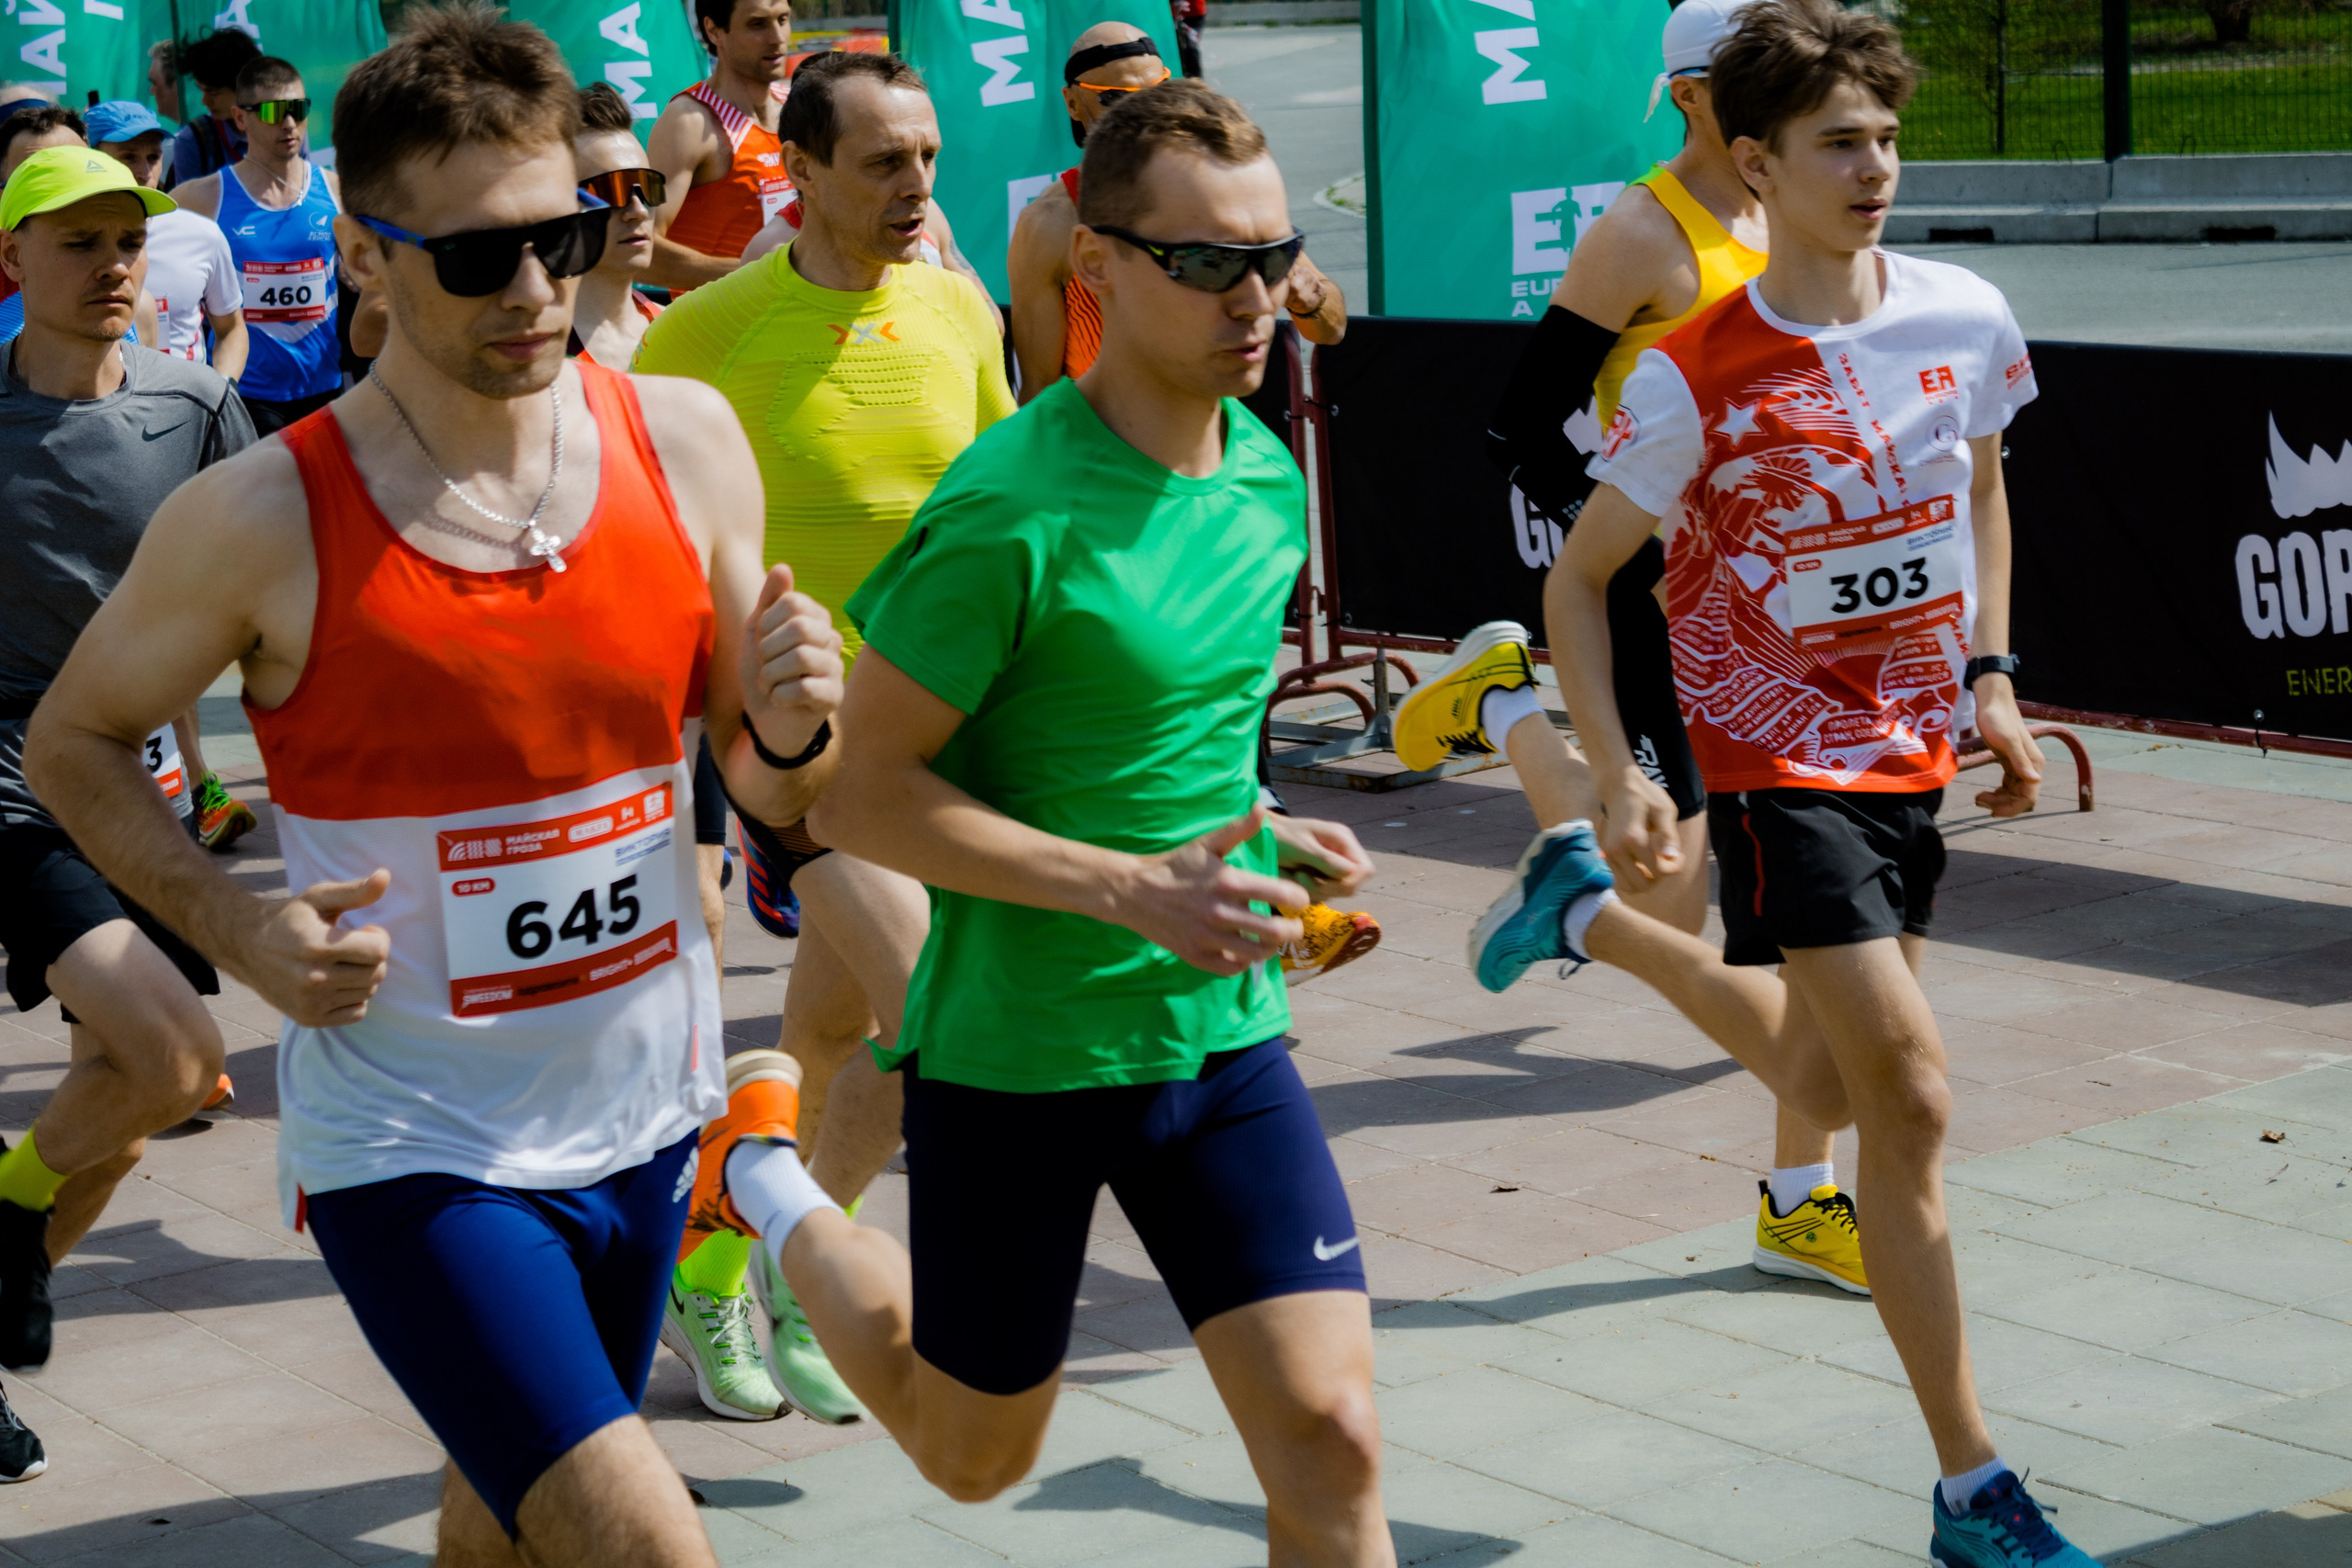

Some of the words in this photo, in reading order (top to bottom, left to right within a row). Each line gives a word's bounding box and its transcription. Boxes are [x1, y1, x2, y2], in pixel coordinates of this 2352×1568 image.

[260, 286, 312, 307] 460
[1830, 557, 1929, 614] 303
[505, 828, 560, 845] МАЙСКАЯ
[506, 842, 543, 855] ГРОЗА
[506, 874, 640, 960] 645
